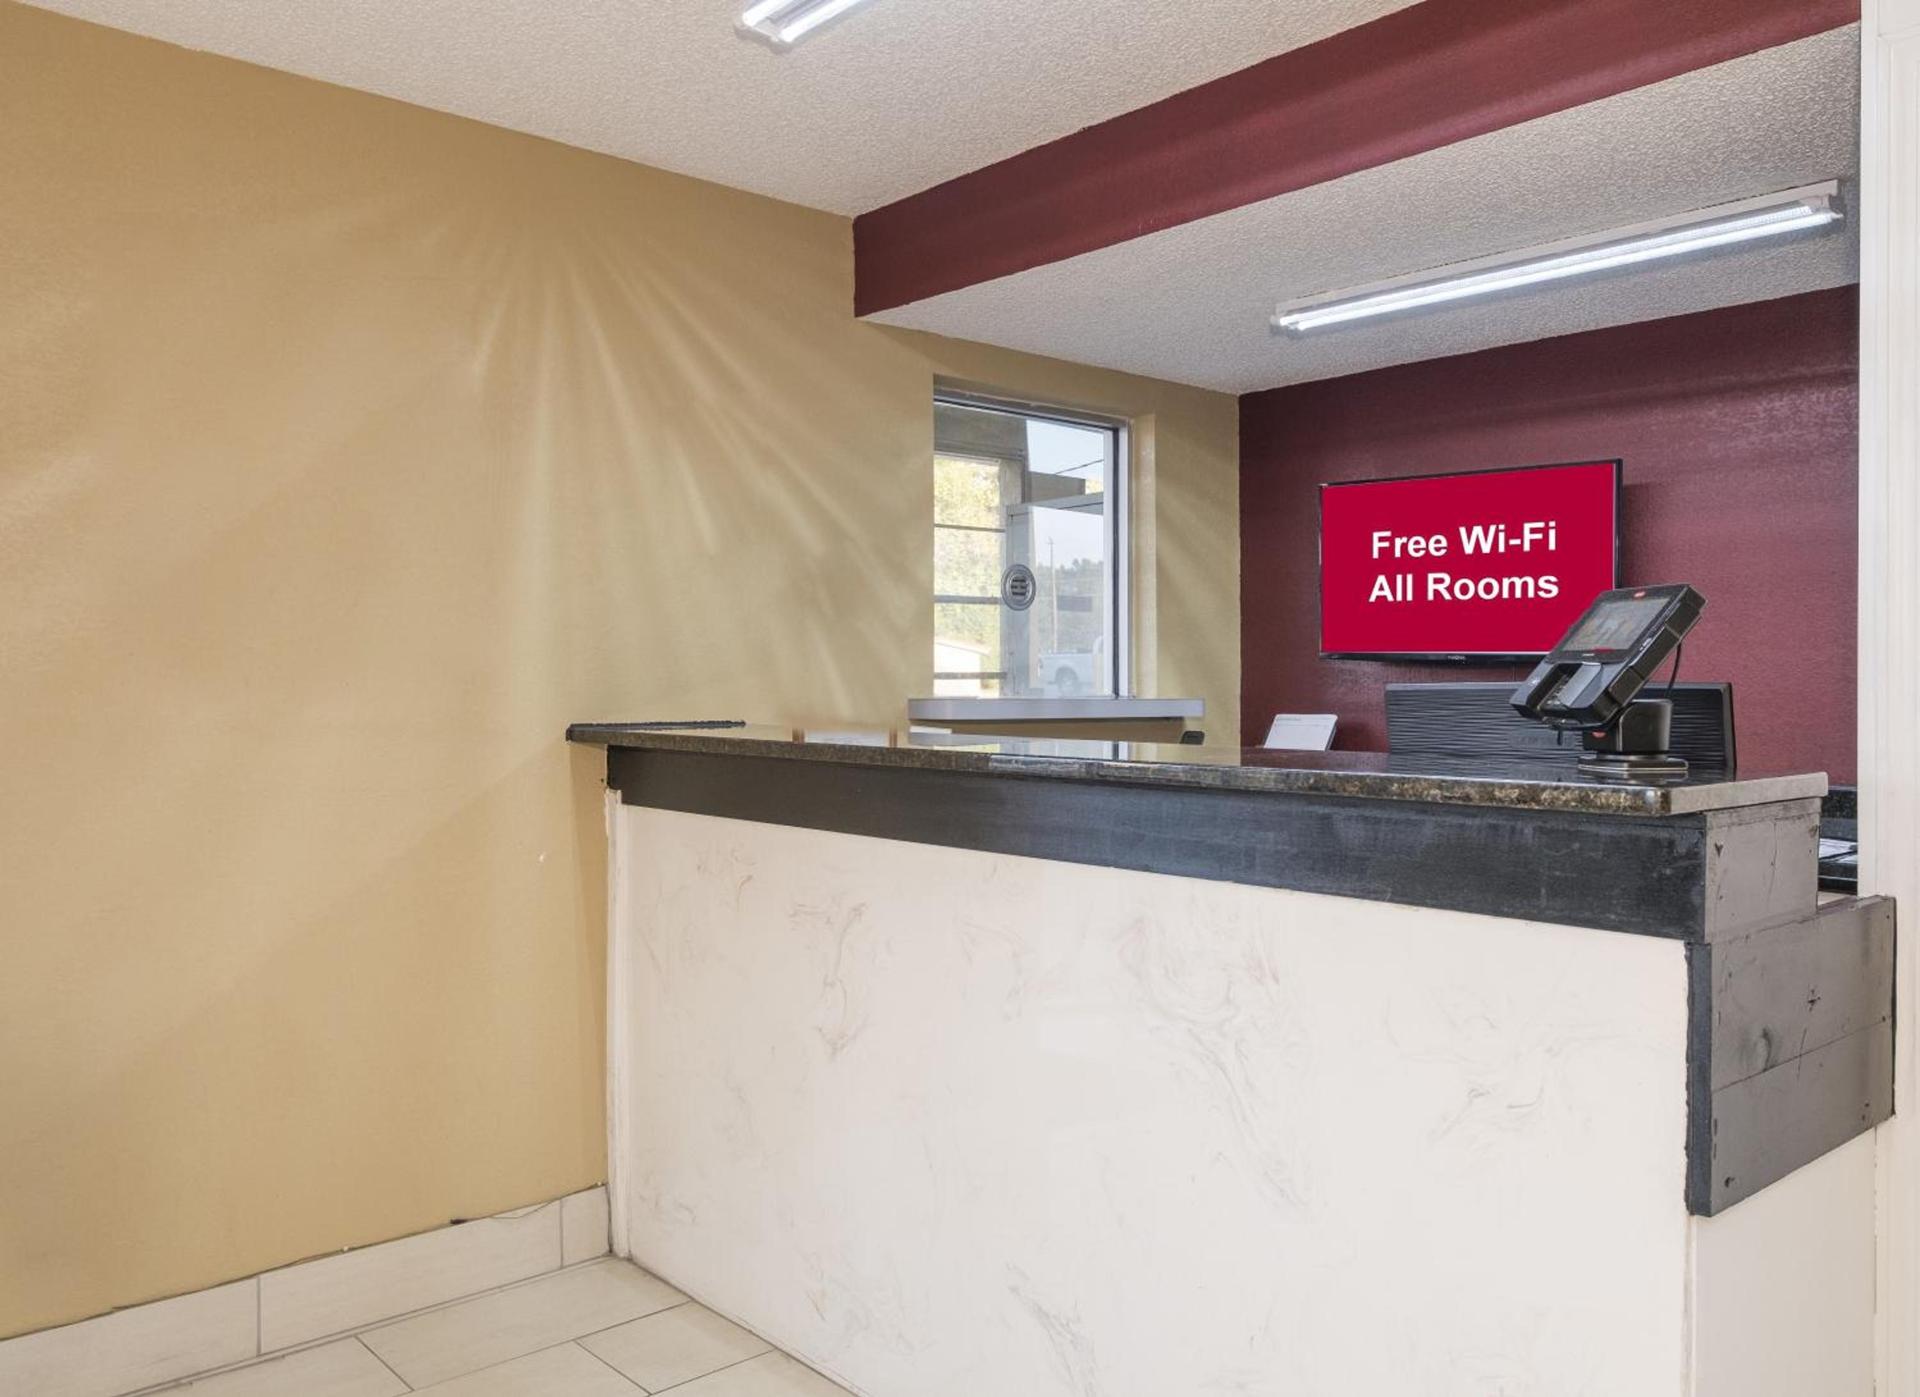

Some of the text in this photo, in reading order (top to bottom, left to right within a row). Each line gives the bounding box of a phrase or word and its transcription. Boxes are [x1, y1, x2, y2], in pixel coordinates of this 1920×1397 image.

[1372, 520, 1556, 559] Free Wi-Fi
[1368, 572, 1559, 603] All Rooms
